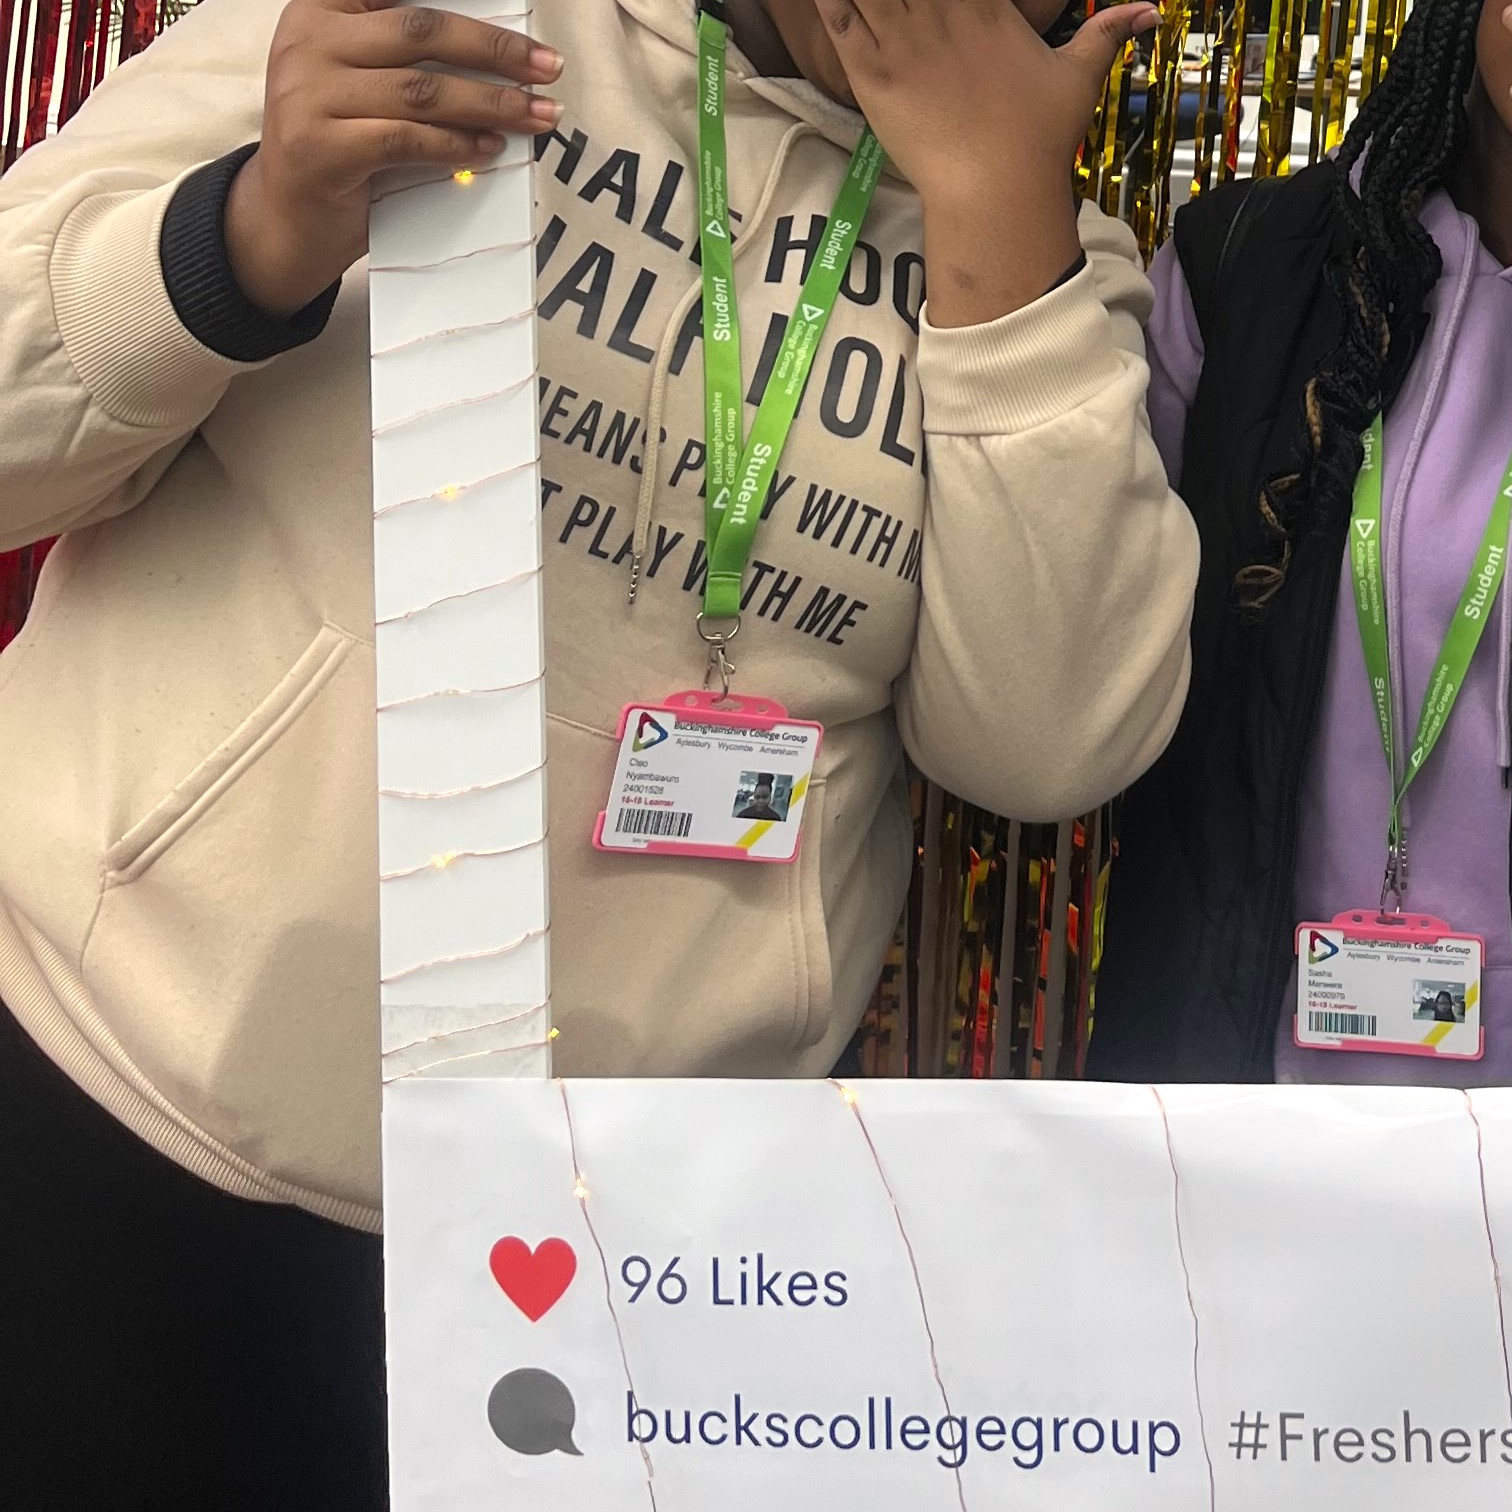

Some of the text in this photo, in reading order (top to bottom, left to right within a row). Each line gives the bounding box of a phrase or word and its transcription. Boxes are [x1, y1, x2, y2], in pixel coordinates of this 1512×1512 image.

[703, 55, 719, 117] Student
[819, 219, 853, 270] Student
[713, 276, 731, 342] Student
[712, 390, 723, 485] Buckinghamshire
[725, 406, 737, 485] College Group
[730, 442, 773, 525] Student
[796, 481, 903, 570] WITH
[1358, 578, 1369, 612] Group
[1366, 539, 1381, 625] Buckinghamshire
[1463, 543, 1505, 620] Student
[793, 584, 869, 647] ME
[1435, 681, 1455, 713] Group
[781, 732, 809, 744] Group
[1445, 944, 1471, 955] Group
[620, 1252, 850, 1308] 96 Likes
[626, 1390, 1182, 1474] buckscollegegroup
